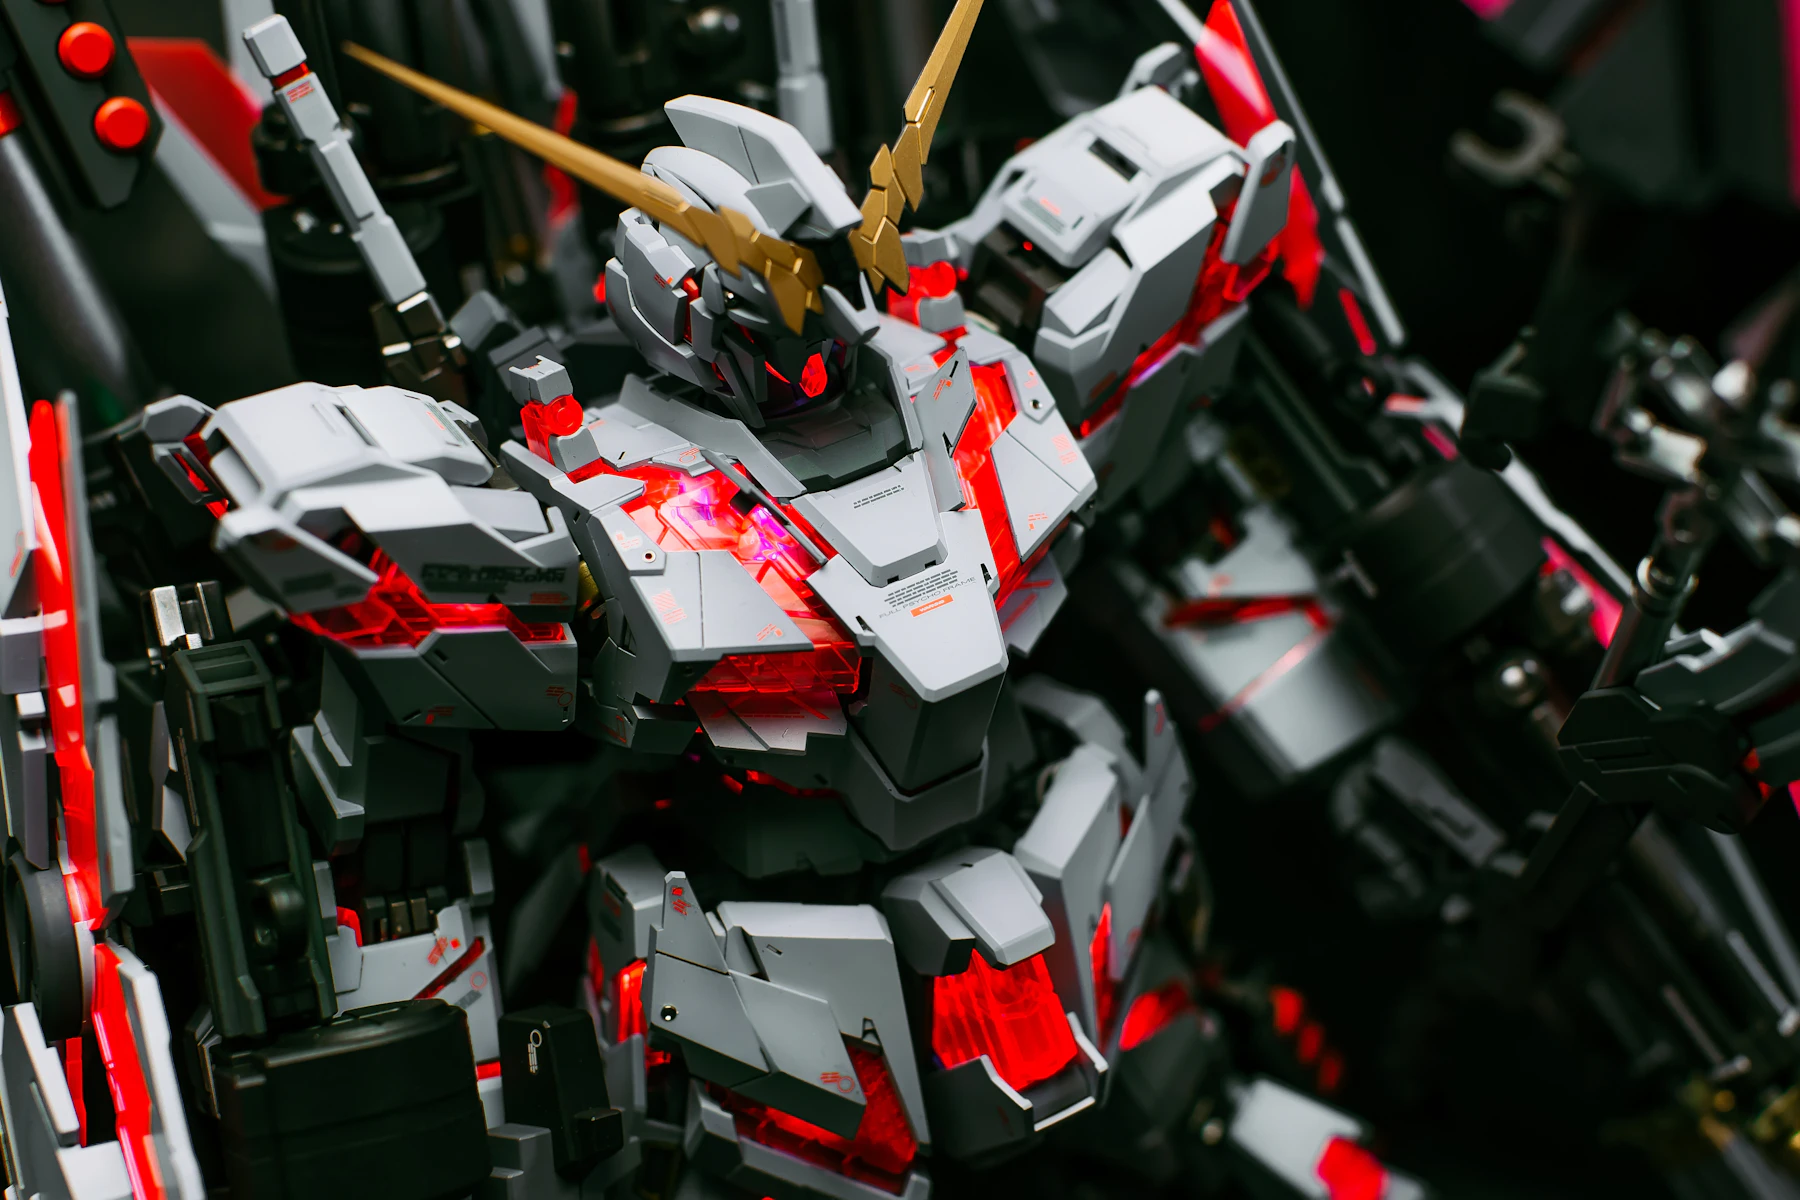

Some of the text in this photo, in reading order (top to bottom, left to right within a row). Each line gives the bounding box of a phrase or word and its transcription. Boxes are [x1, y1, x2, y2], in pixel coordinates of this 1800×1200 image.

[878, 607, 902, 619] FULL
[902, 590, 942, 609] PSYCHO
[943, 576, 976, 593] FRAME
